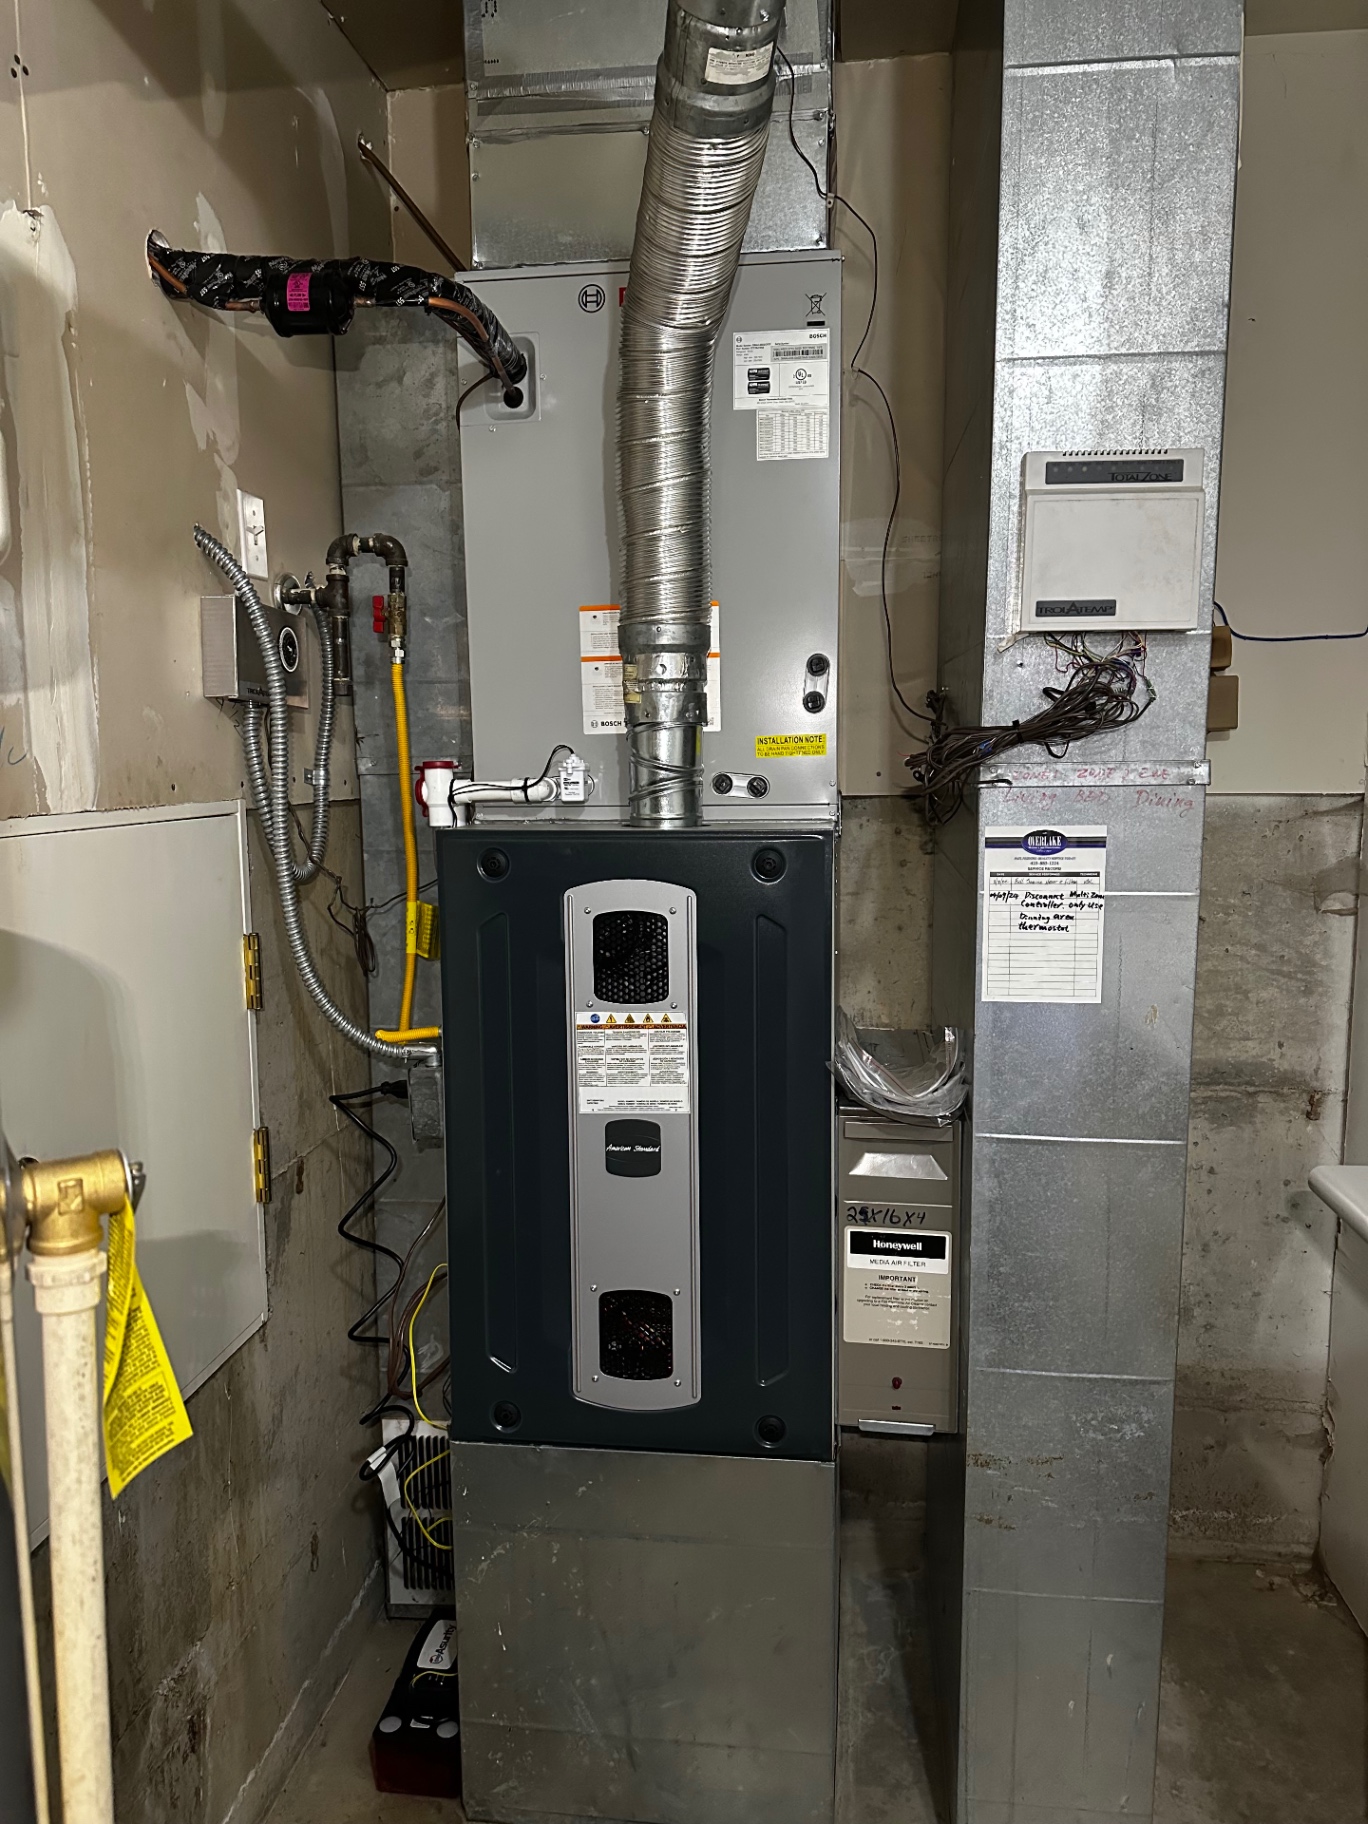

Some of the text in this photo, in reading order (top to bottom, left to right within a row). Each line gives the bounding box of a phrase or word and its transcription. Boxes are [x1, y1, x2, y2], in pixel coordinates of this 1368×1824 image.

[757, 736, 804, 745] INSTALLATION
[1134, 788, 1195, 818] Dining
[1027, 836, 1062, 847] OVERLAKE
[872, 1239, 923, 1251] Honeywell
[869, 1258, 890, 1266] MEDIA
[878, 1274, 917, 1283] IMPORTANT
